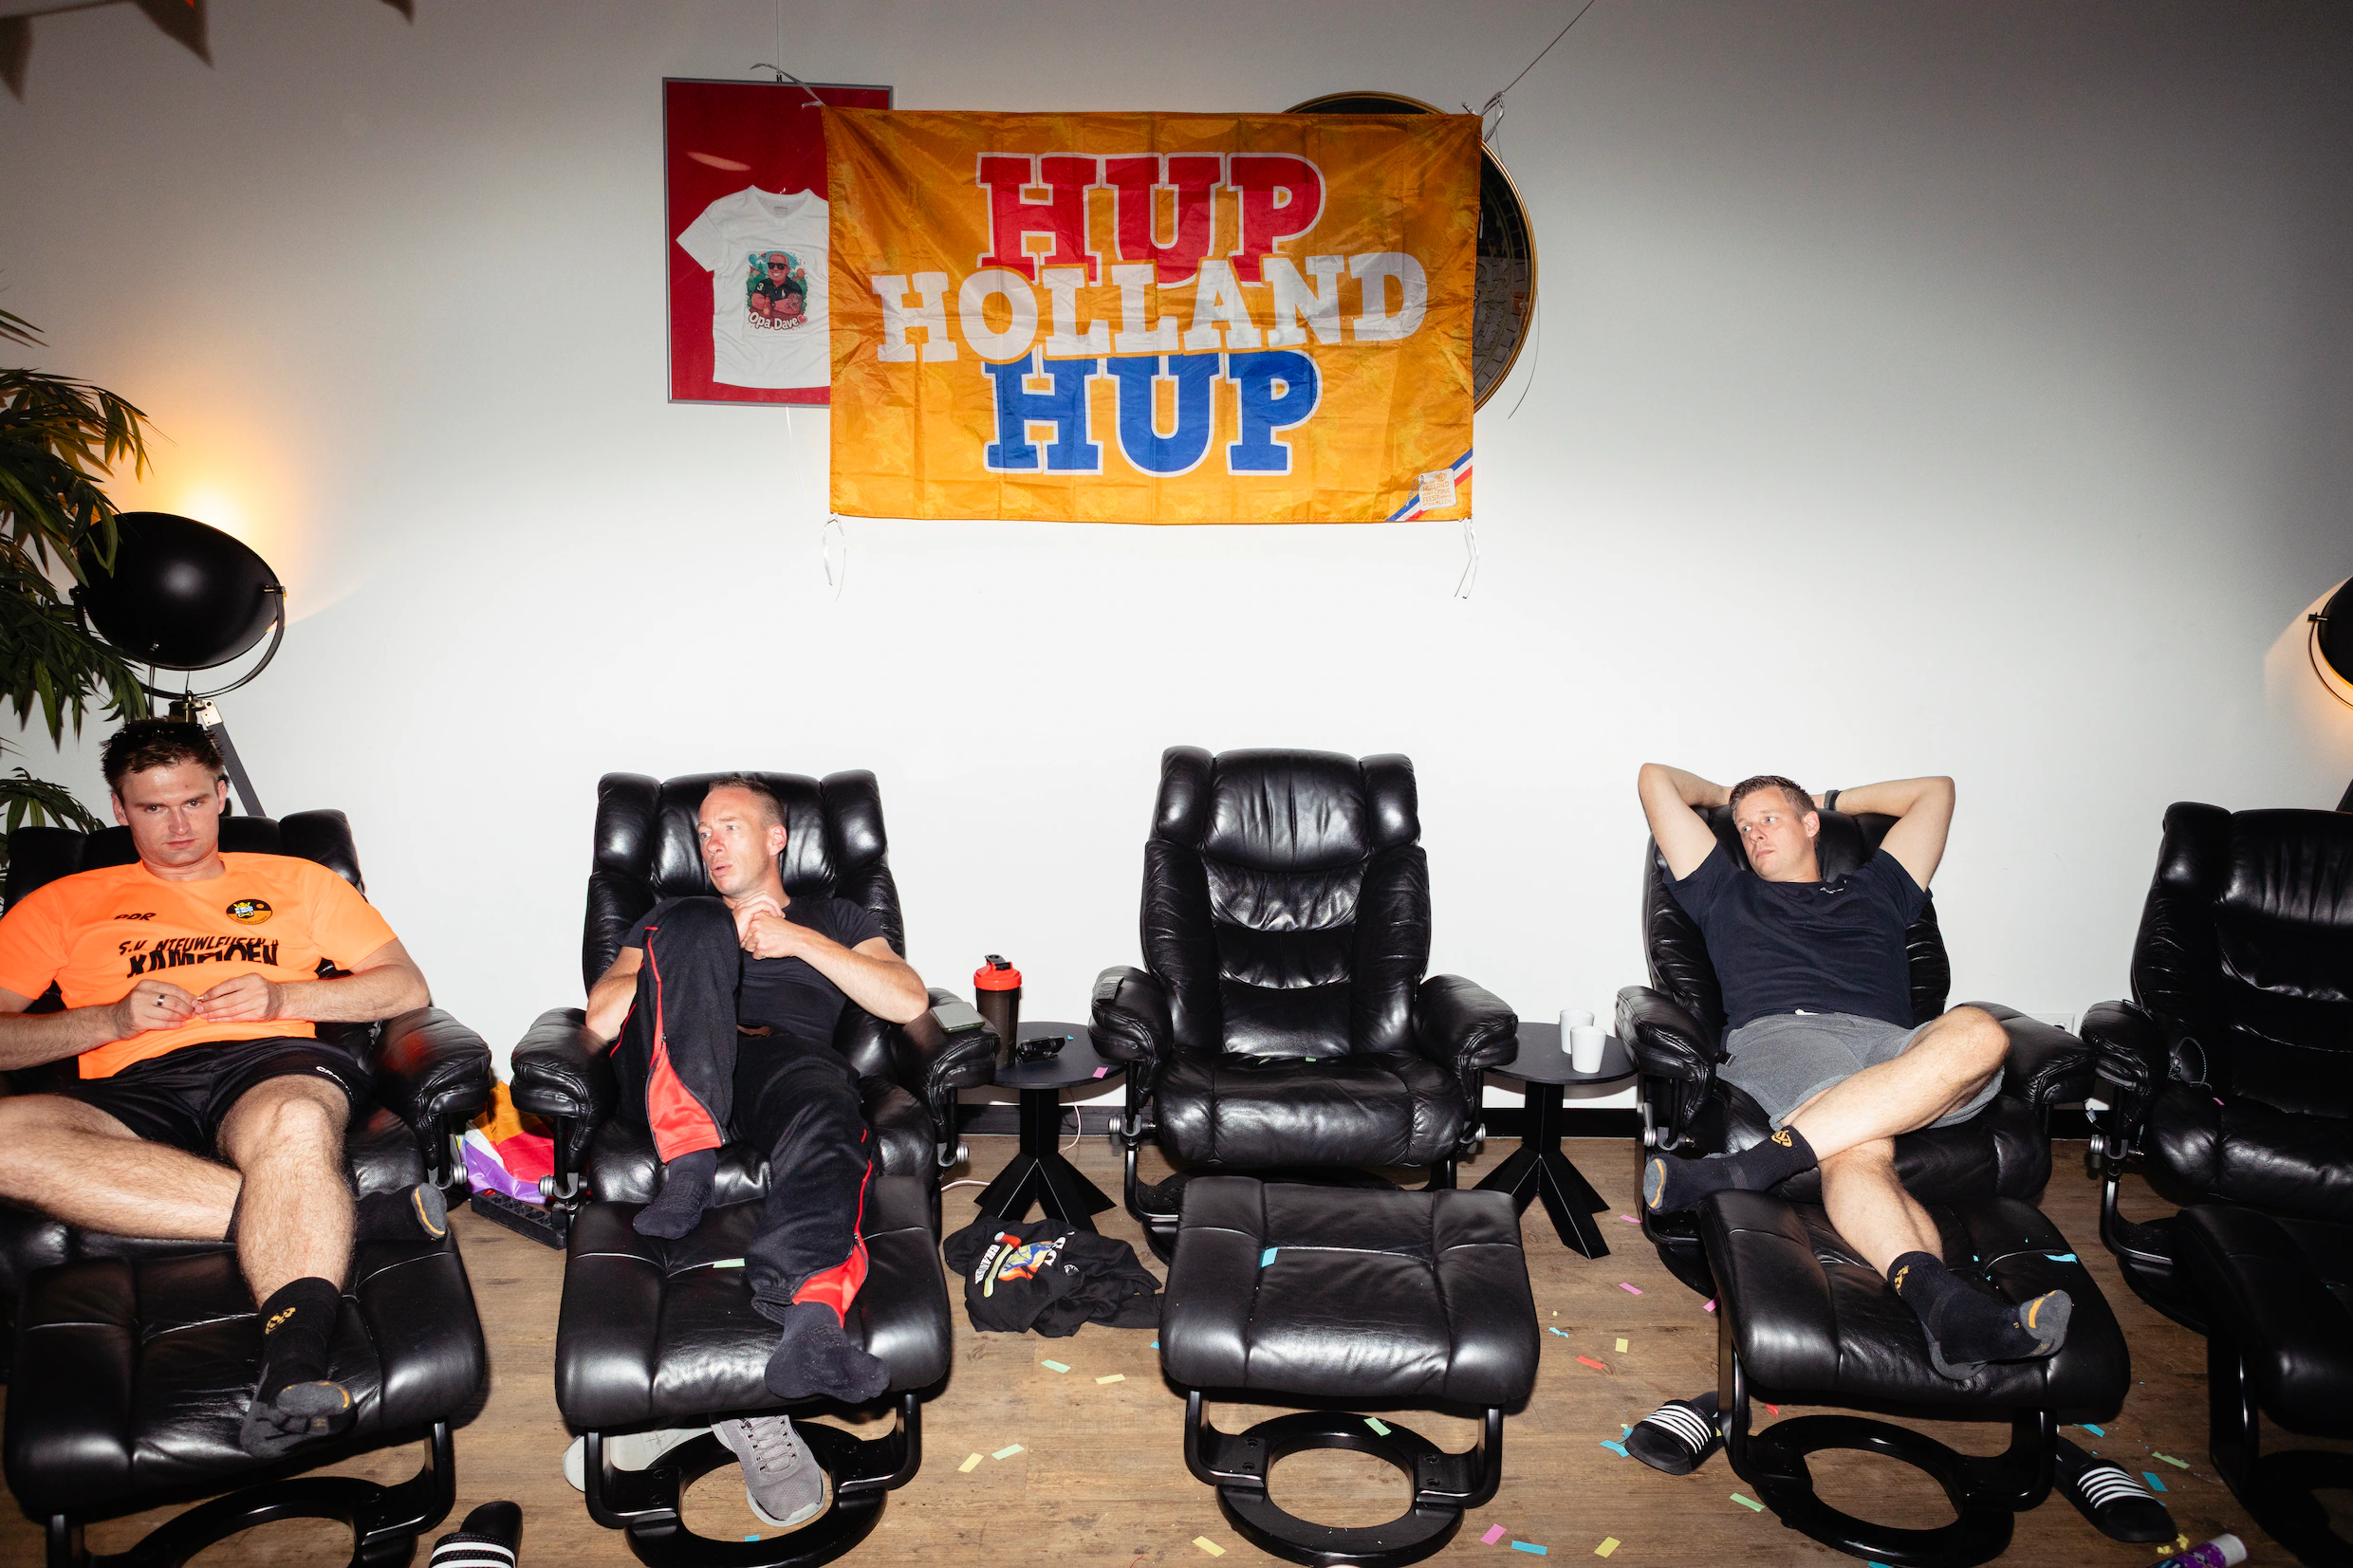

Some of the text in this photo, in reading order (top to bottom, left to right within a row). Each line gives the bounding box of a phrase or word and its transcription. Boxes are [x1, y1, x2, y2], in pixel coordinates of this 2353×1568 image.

[977, 153, 1325, 287] HUP
[749, 311, 799, 330] Opa Dave
[757, 282, 765, 291] 3
[870, 252, 1427, 363] HOLLAND
[981, 349, 1323, 478] HUP
